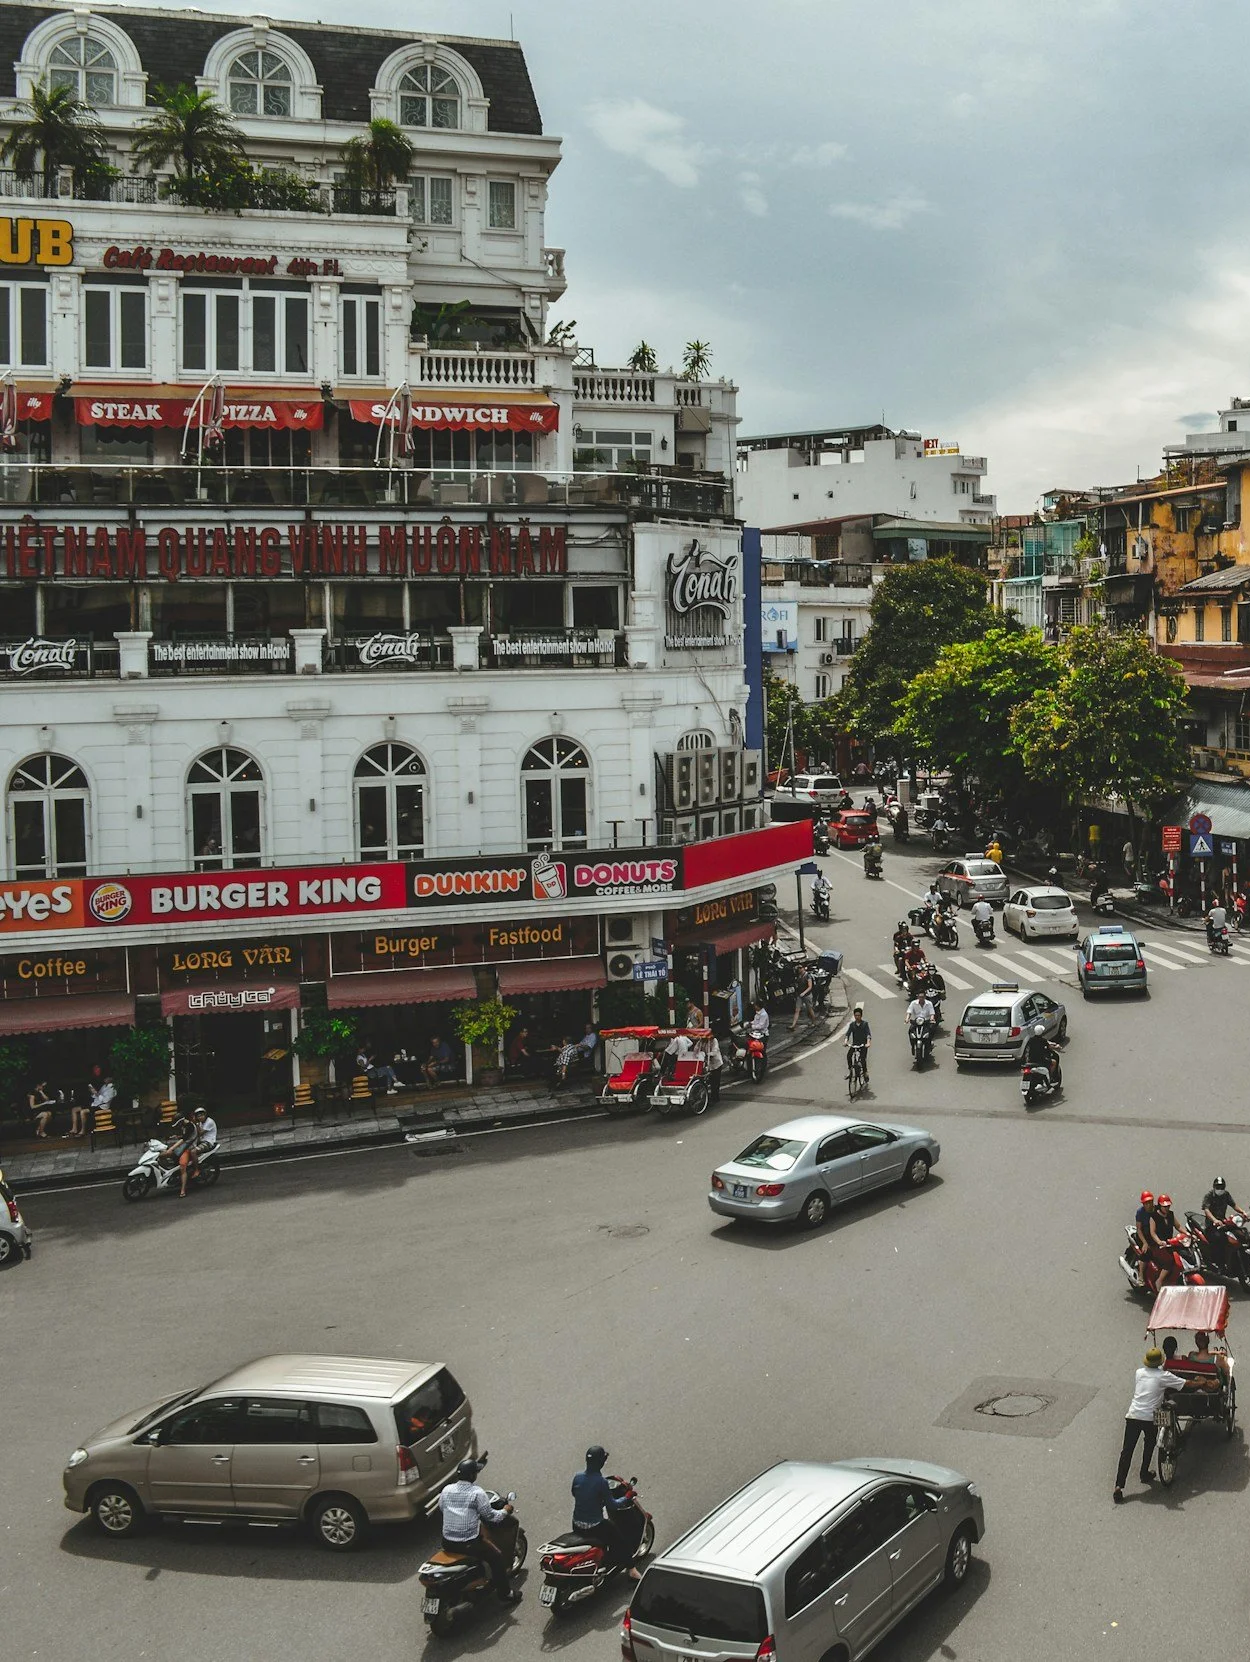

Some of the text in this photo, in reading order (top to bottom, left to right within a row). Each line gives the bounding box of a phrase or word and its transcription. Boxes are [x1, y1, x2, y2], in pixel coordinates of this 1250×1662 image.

[103, 246, 152, 269] Café
[156, 248, 278, 275] Restaurant
[286, 257, 319, 275] 4th
[27, 398, 41, 408] illy
[91, 402, 162, 421] STEAK
[293, 409, 308, 421] illy
[529, 412, 544, 423] illy
[158, 527, 281, 583] QUANG
[288, 525, 367, 577] VINH
[153, 643, 290, 660] The best entertainment show in Hanoi
[493, 640, 505, 655] The
[506, 640, 521, 655] best
[522, 639, 569, 654] entertainment
[570, 638, 587, 653] show
[588, 638, 594, 653] in
[414, 860, 678, 897] DUNKIN' DONUTS
[95, 891, 125, 904] BURGER
[151, 876, 382, 914] BURGER KING
[97, 897, 127, 914] KING
[695, 897, 727, 924] LONG
[375, 935, 438, 957] Burger
[490, 925, 562, 947] Fastfood
[172, 945, 291, 970] LONG VÂN
[18, 959, 87, 980] Coffee
[636, 970, 643, 979] LÊ
